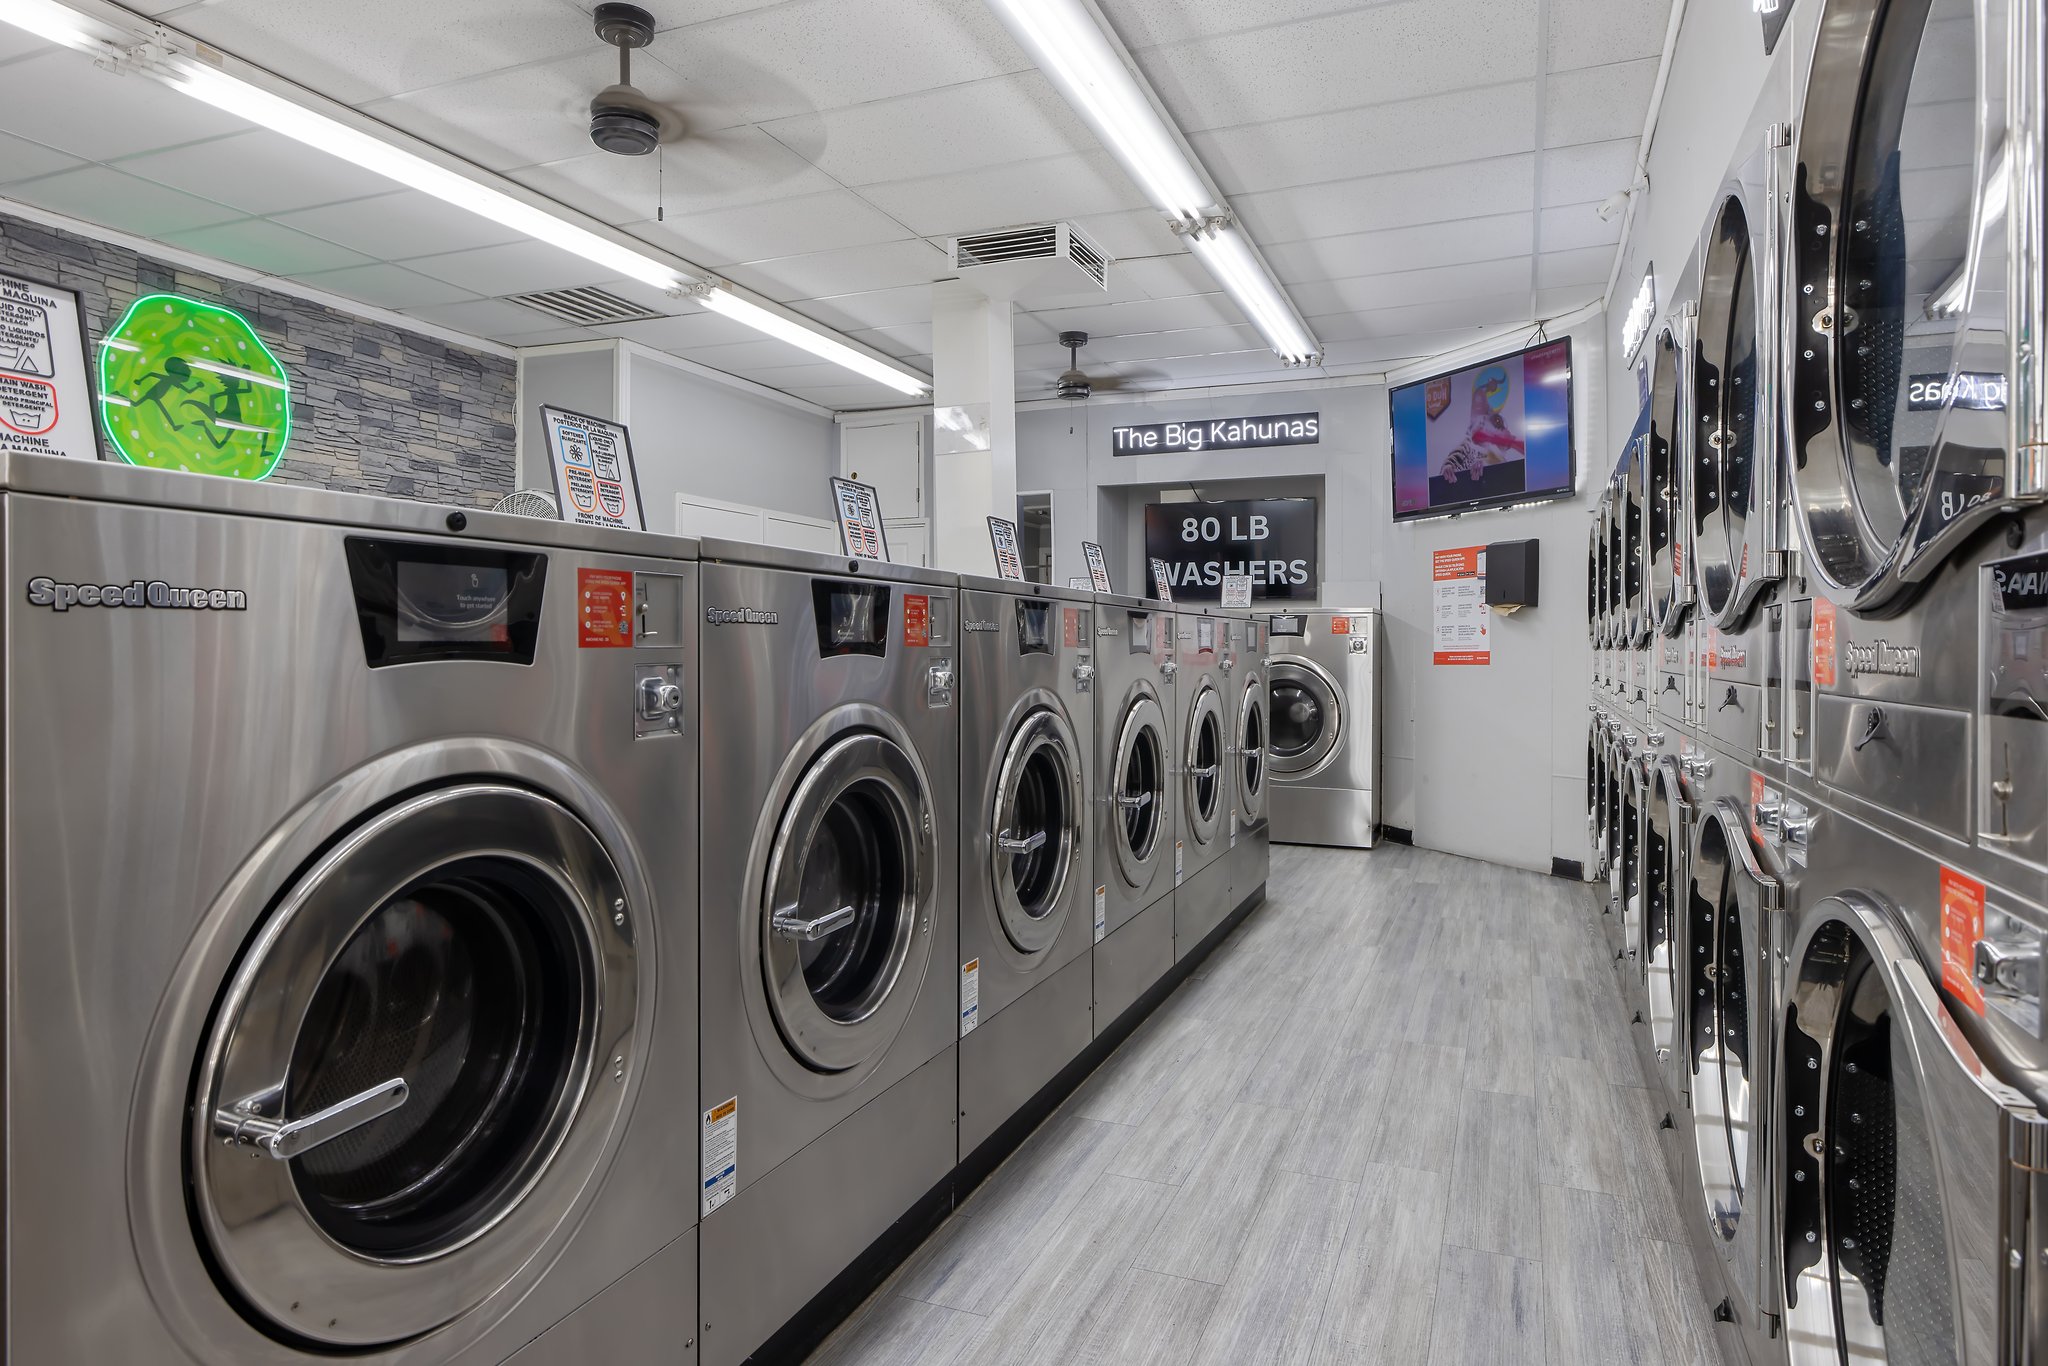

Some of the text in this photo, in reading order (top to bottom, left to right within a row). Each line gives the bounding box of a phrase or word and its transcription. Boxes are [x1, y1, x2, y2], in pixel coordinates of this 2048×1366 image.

[3, 288, 57, 309] MAQUINA
[17, 306, 42, 318] ONLY
[8, 325, 45, 339] LIQUIDOS
[20, 381, 46, 391] WASH
[2, 400, 45, 412] DETERGENTE
[20, 397, 54, 408] PRINCIPAL
[1114, 419, 1318, 451] The Big Kahunas
[1181, 515, 1270, 543] 80 LB
[29, 577, 247, 611] Speed Queen
[707, 606, 778, 626] Speed Queen
